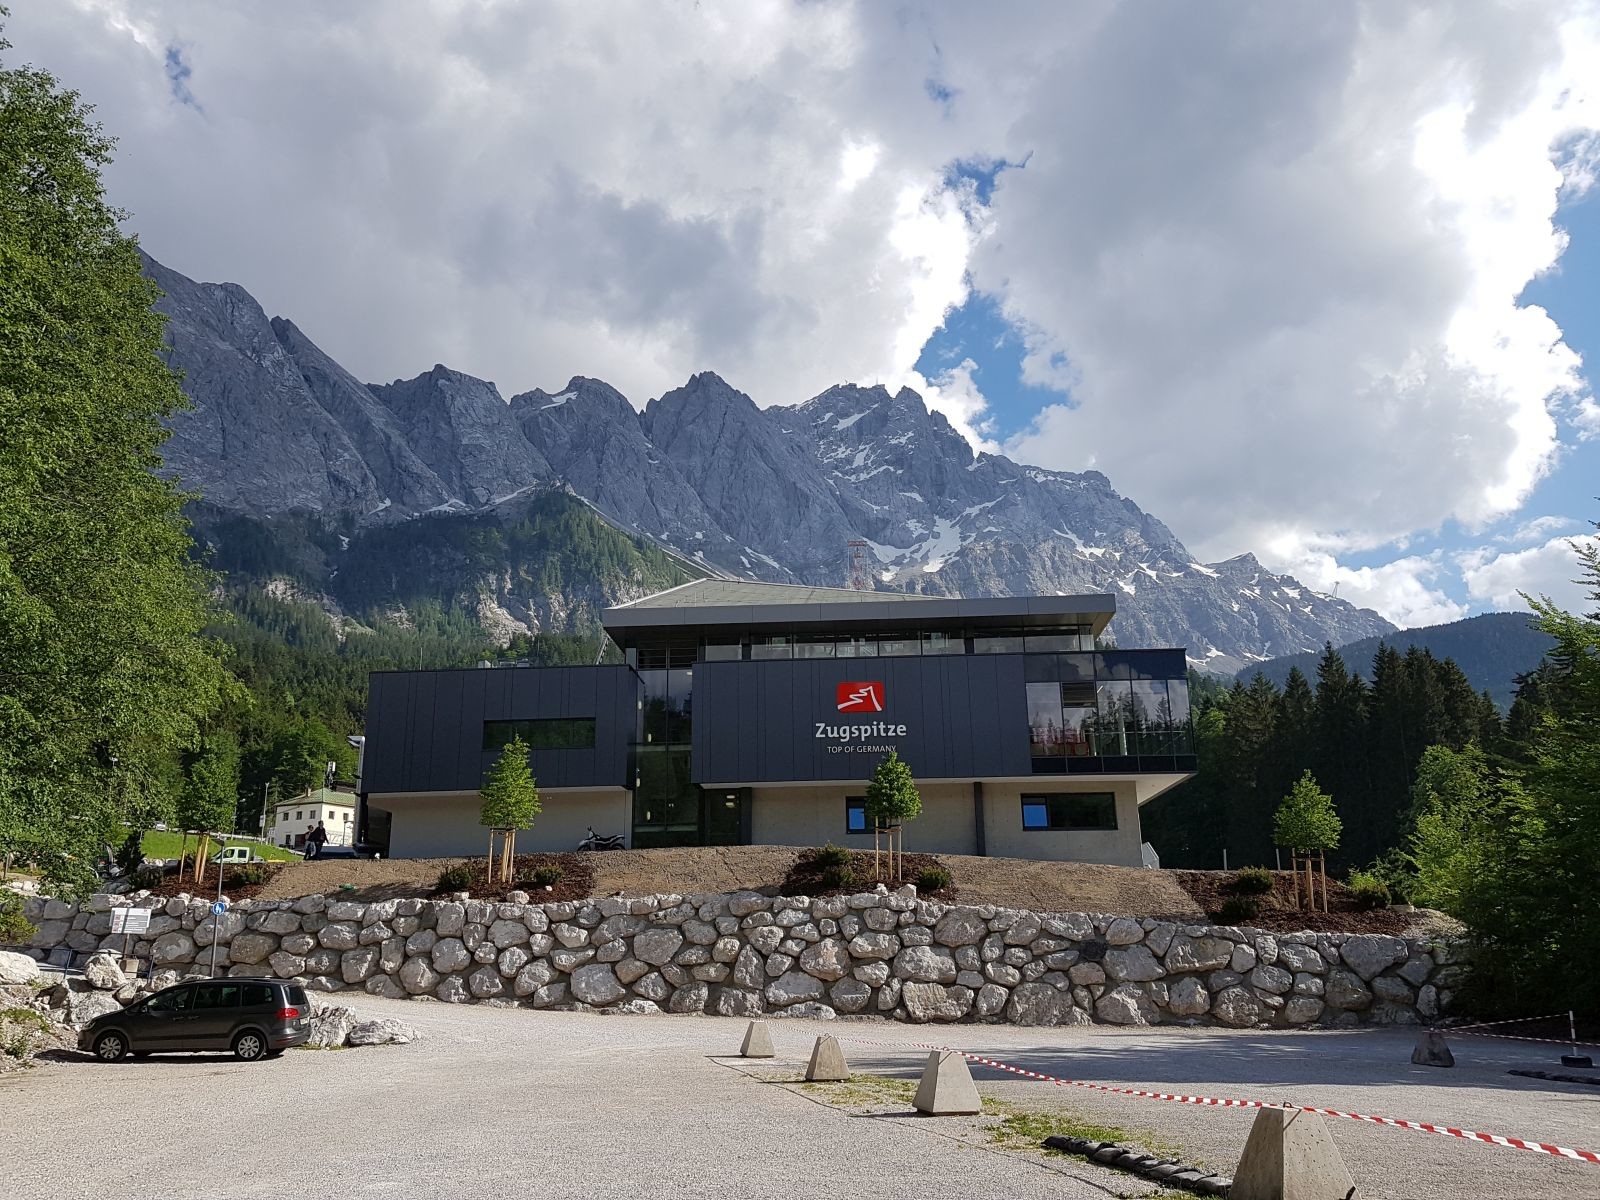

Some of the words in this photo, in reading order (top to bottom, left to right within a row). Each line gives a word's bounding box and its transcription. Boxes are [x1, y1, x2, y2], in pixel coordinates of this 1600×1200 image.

[815, 721, 907, 742] Zugspitze
[844, 745, 855, 753] OF
[857, 745, 896, 753] GERMANY
